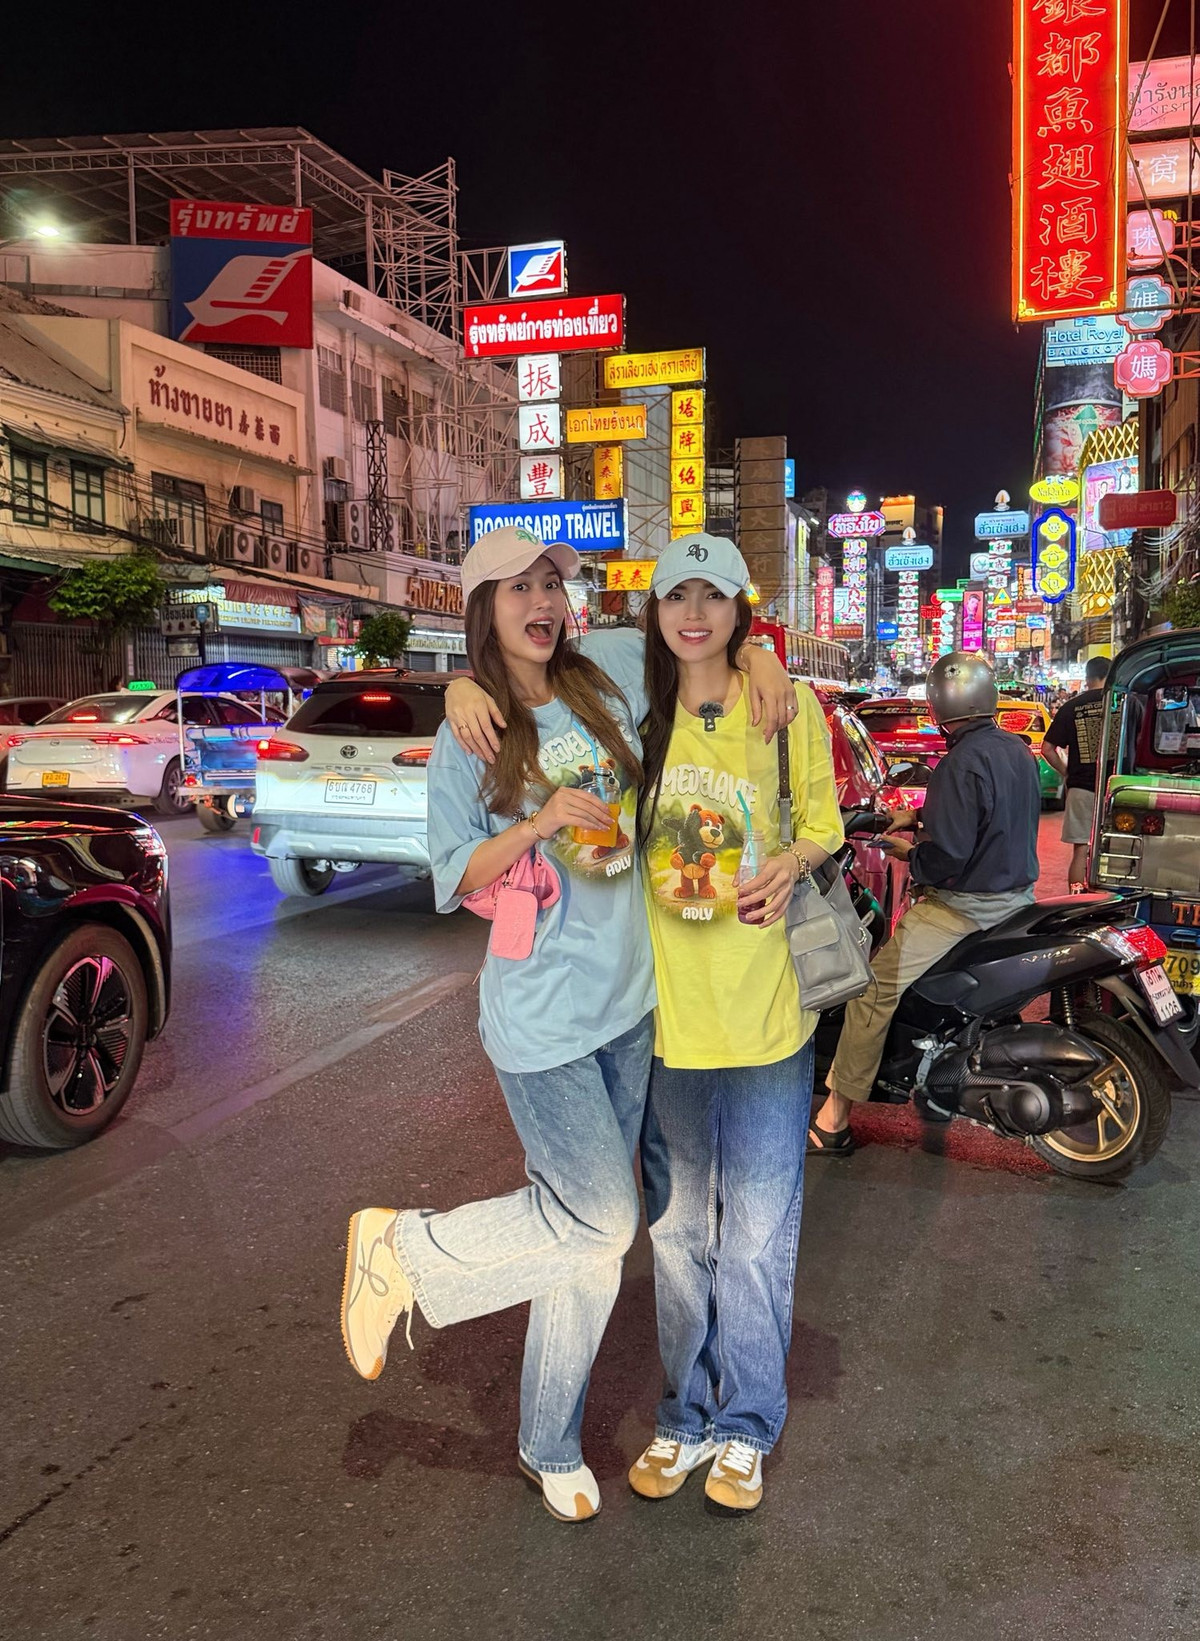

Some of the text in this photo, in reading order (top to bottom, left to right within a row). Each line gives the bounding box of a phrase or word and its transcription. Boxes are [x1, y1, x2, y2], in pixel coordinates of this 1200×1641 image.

[176, 203, 306, 236] รุ่งทรัพย์
[469, 298, 618, 355] รุ่งทรัพย์การท่องเที่ยว
[1048, 325, 1124, 343] Hotel Royal
[1048, 344, 1124, 358] BANGKOK
[565, 511, 620, 540] TRAVEL
[350, 782, 373, 794] 4768
[605, 853, 632, 877] ADLV
[682, 906, 714, 921] ADLV
